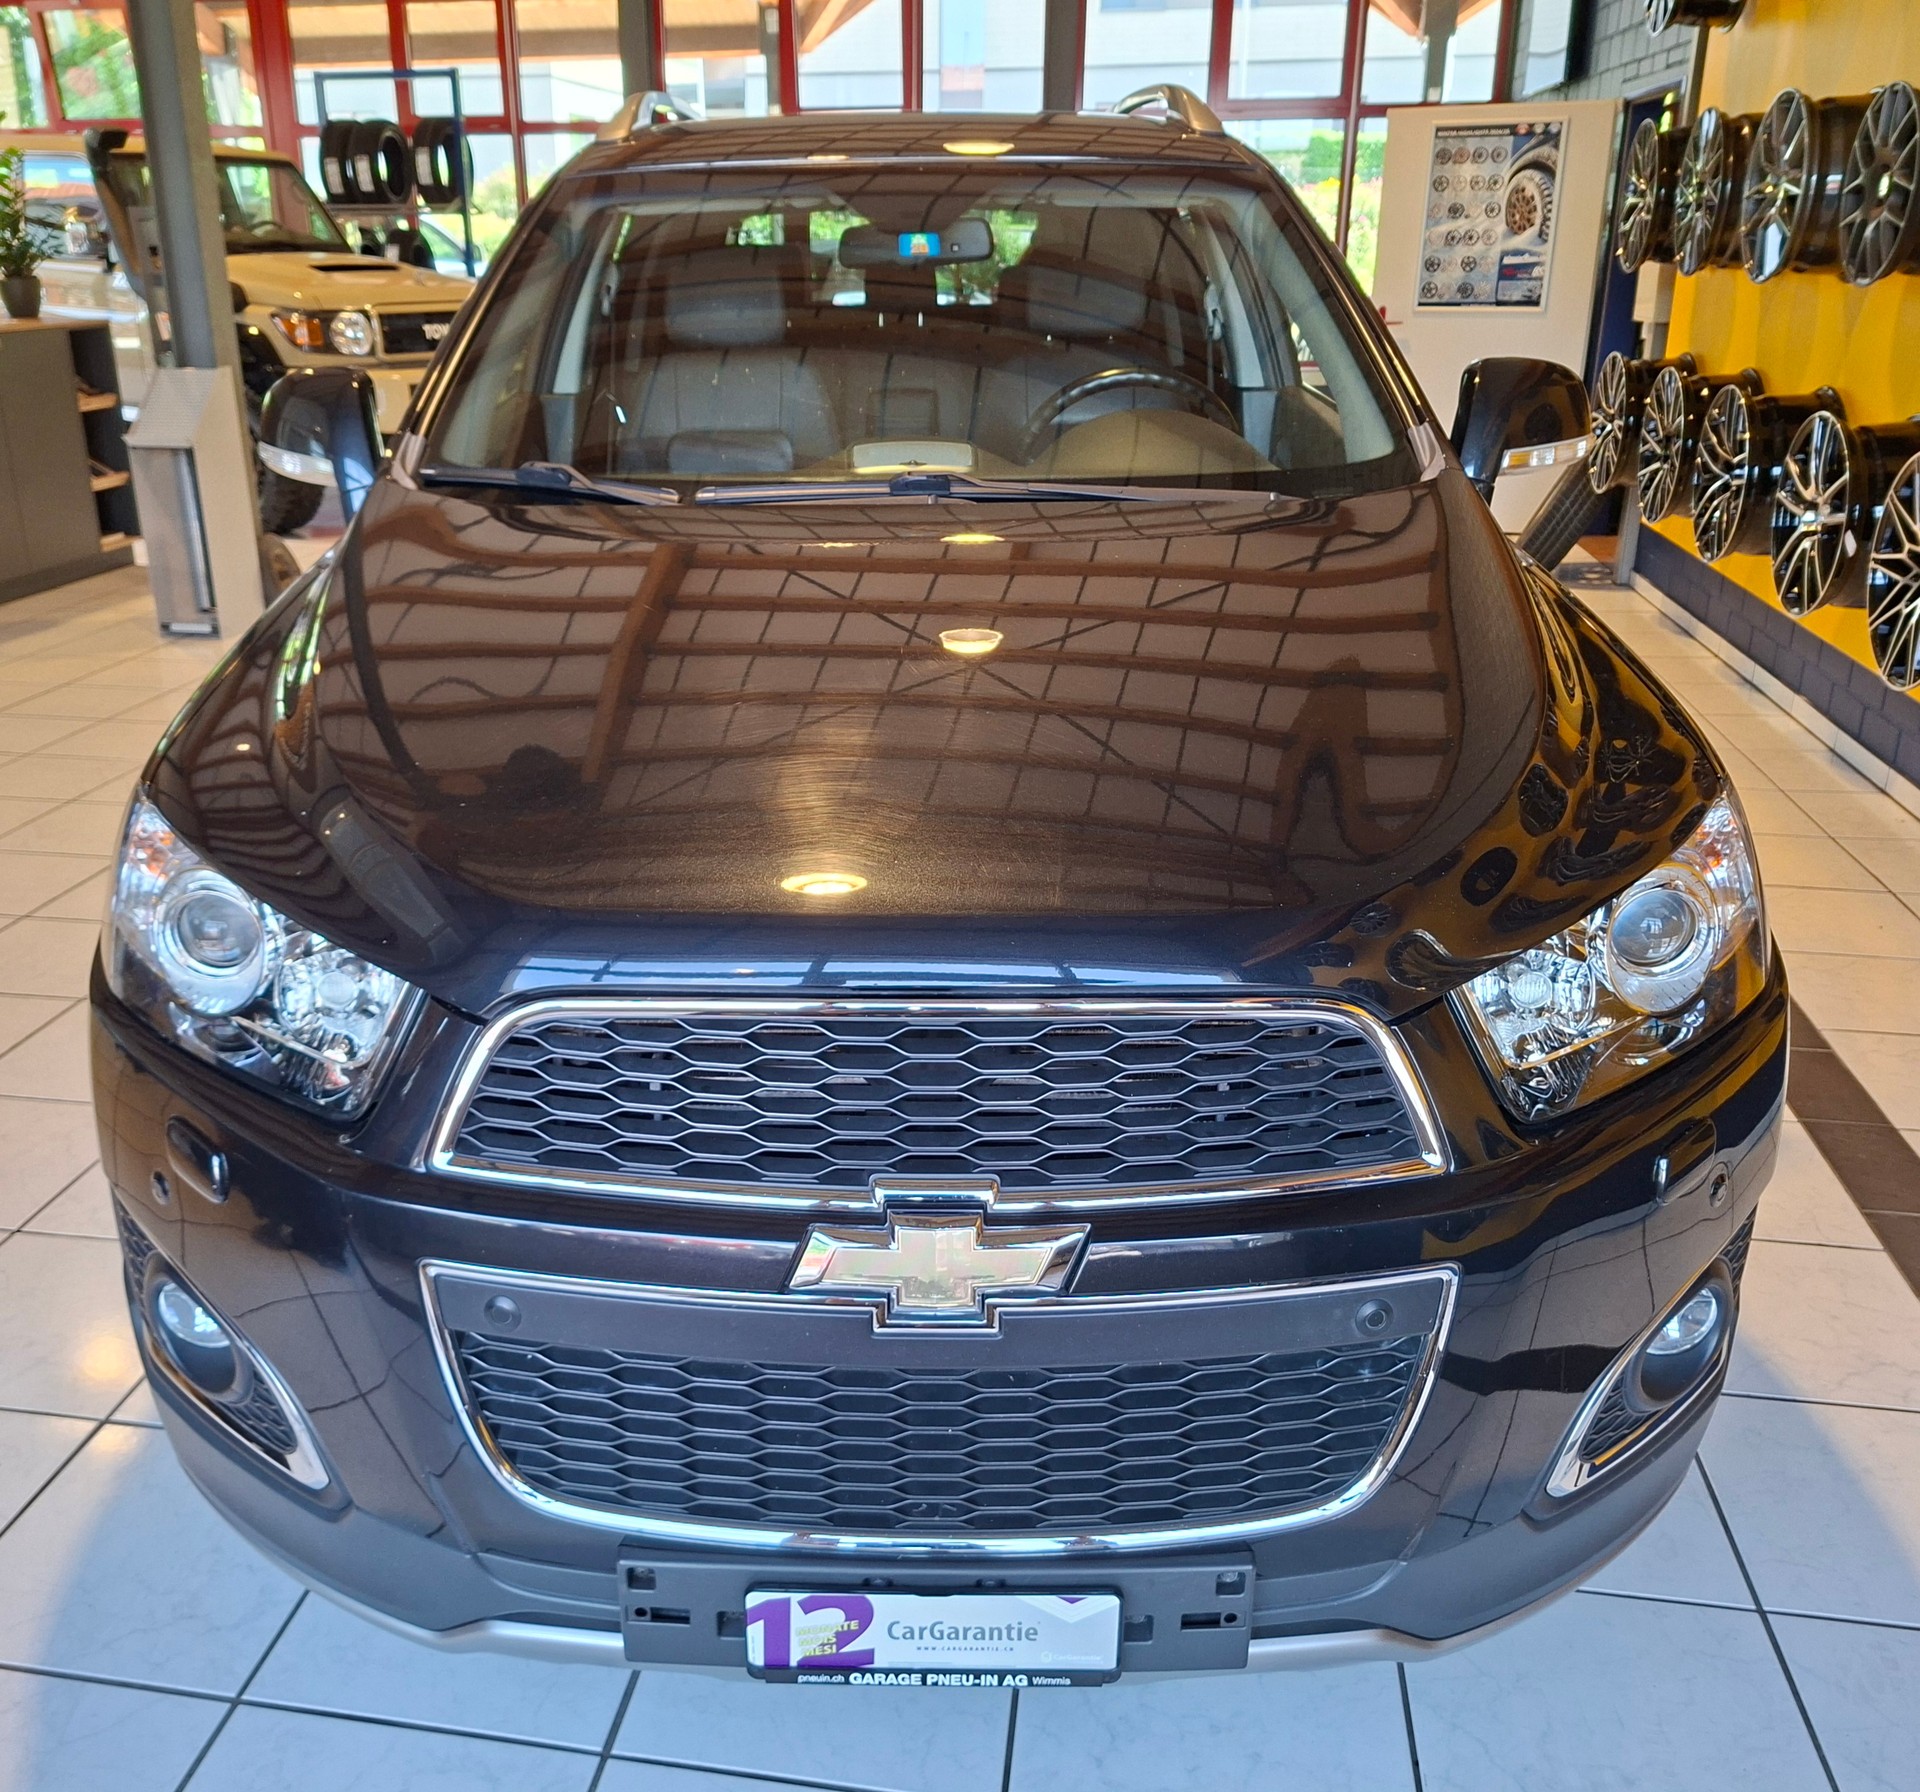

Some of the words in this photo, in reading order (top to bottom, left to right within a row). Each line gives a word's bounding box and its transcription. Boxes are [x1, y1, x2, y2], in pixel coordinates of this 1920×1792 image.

[422, 323, 451, 340] TOY
[746, 1595, 875, 1668] 12
[796, 1619, 859, 1636] MONATE
[887, 1620, 1039, 1641] CarGarantie
[800, 1634, 837, 1647] MOIS
[802, 1644, 837, 1657] MESI
[797, 1673, 845, 1684] pneuin.ch
[849, 1672, 922, 1686] GARAGE
[926, 1673, 999, 1686] PNEU-IN
[1002, 1674, 1029, 1686] AG
[1032, 1676, 1071, 1686] Wimmis
